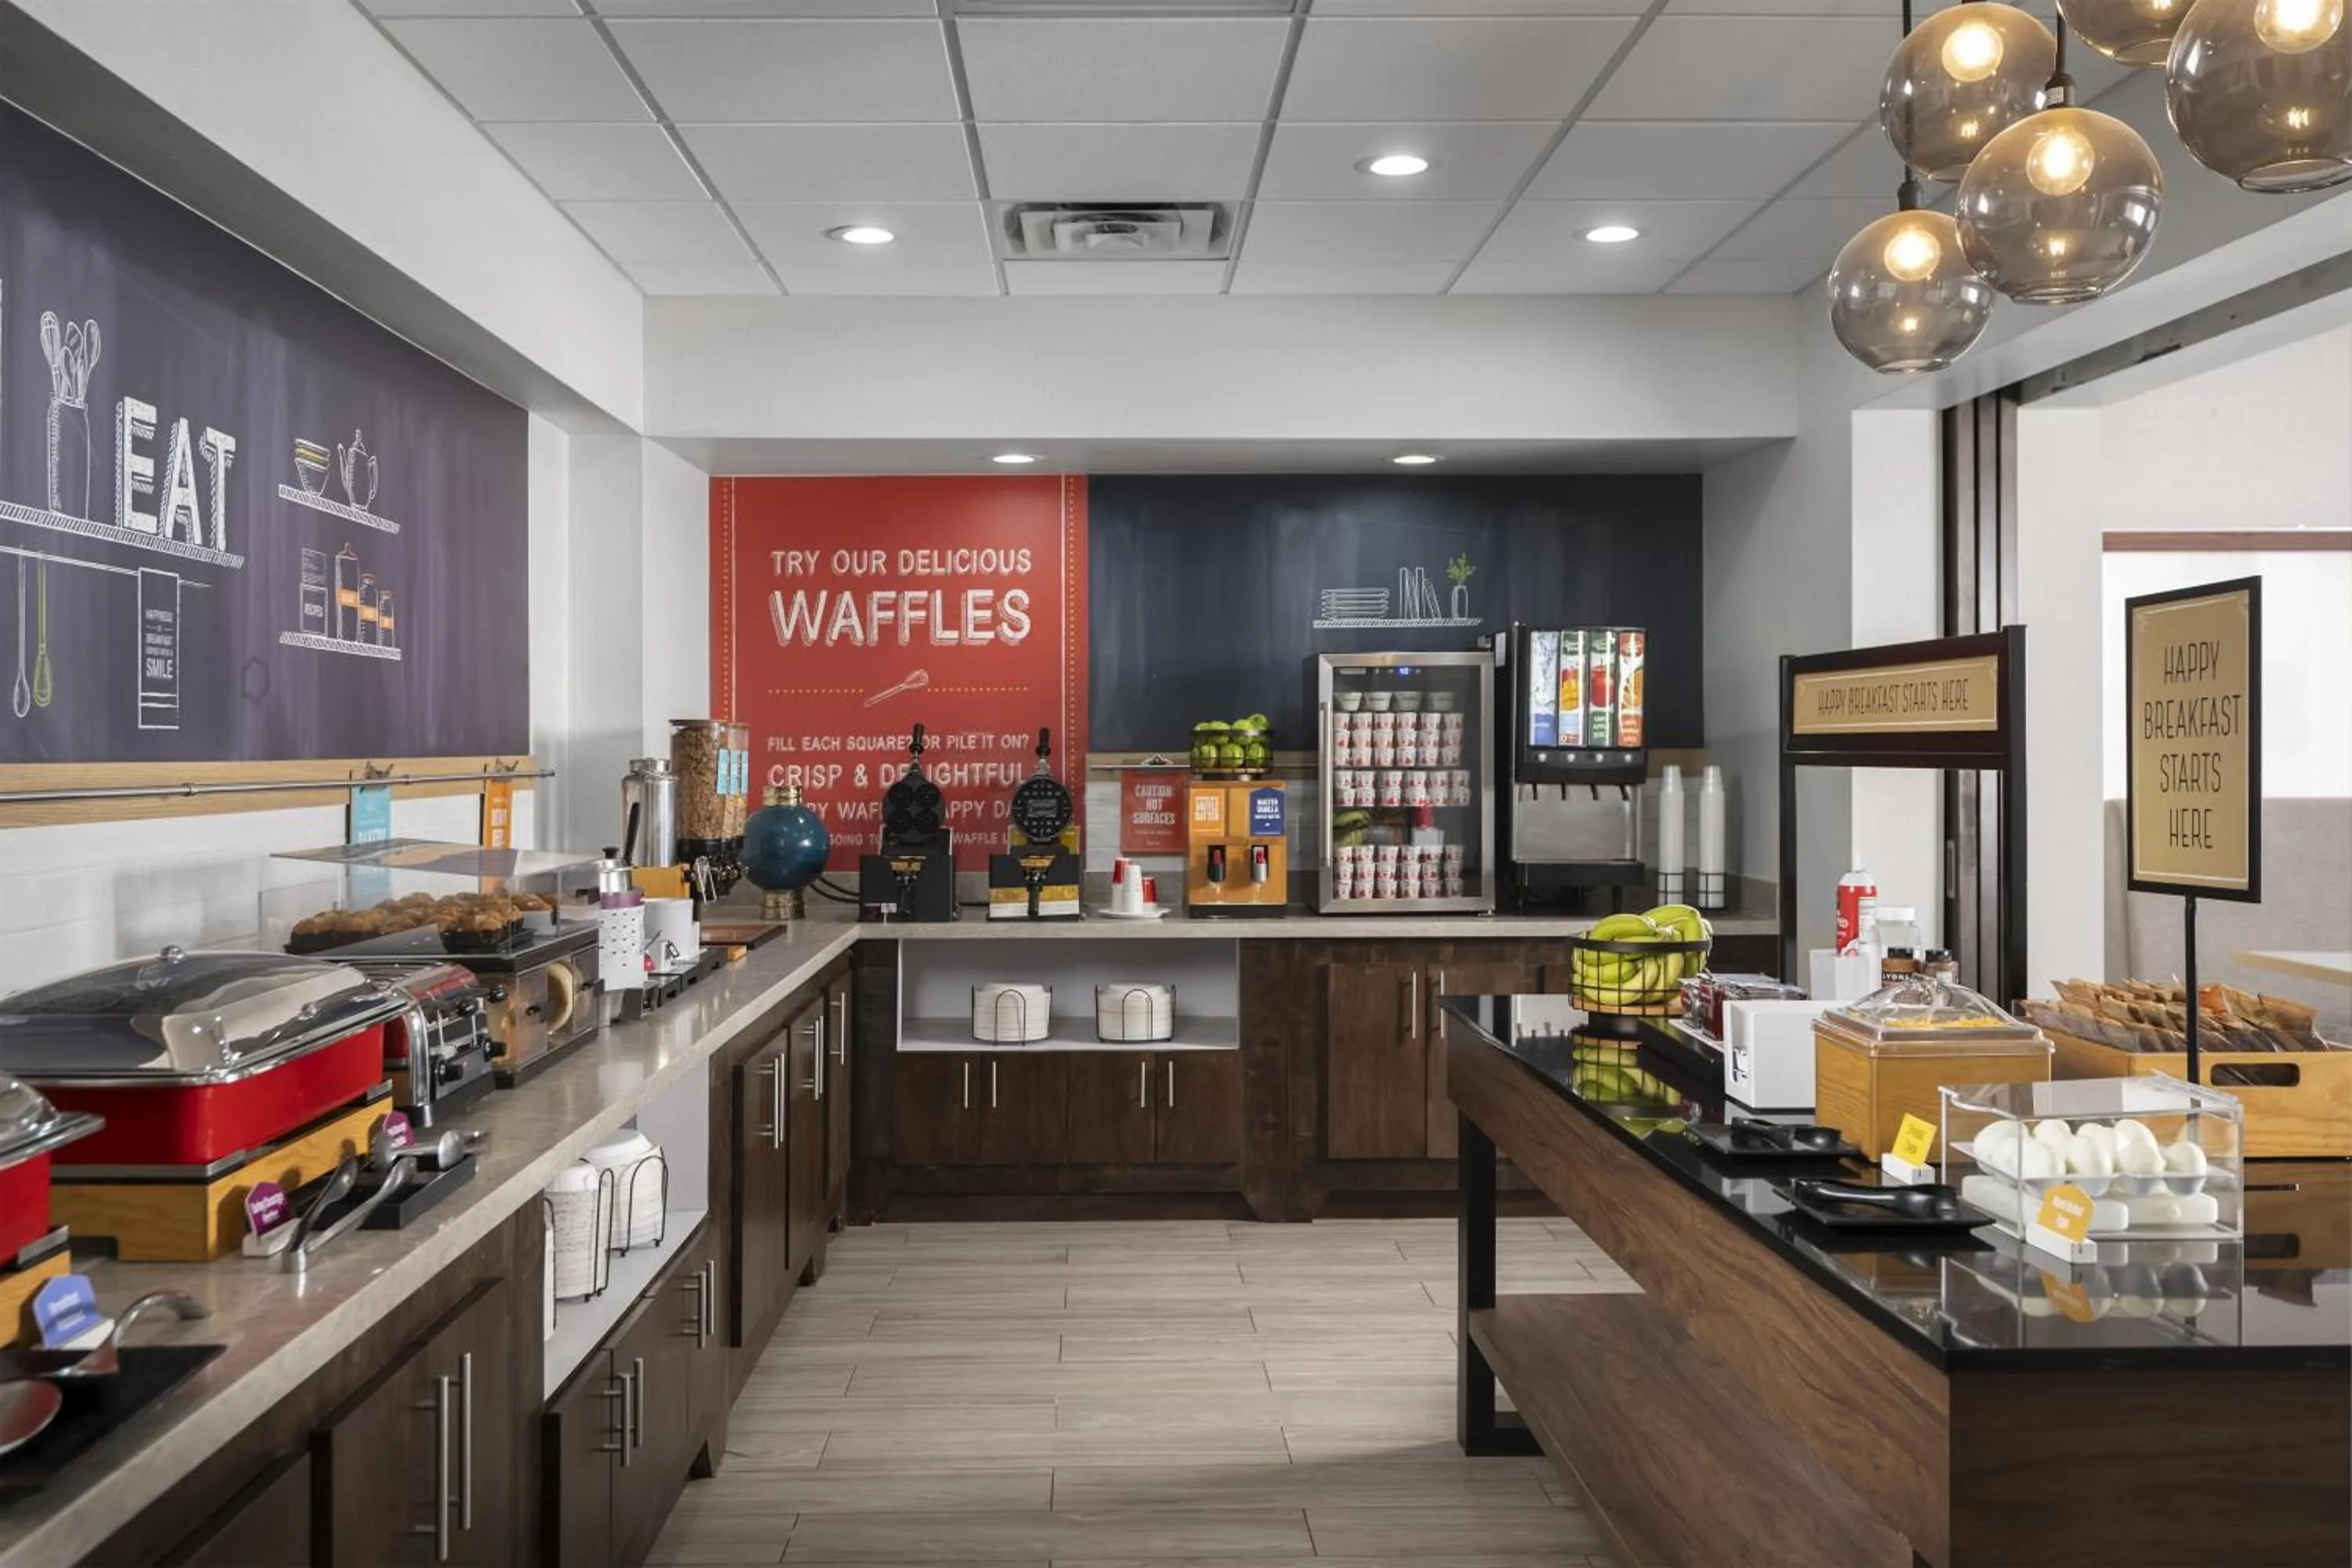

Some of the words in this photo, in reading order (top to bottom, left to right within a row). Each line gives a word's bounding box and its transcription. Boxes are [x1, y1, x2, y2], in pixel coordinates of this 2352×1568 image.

[115, 396, 236, 551] EAT
[771, 550, 820, 576] TRY
[831, 550, 887, 576] OUR
[898, 548, 1032, 576] DELICIOUS
[768, 589, 1031, 647] WAFFLES
[146, 658, 173, 678] SMILE
[2163, 640, 2220, 684] HAPPY
[1818, 688, 1846, 716] HAPPY
[1848, 684, 1900, 717] BREAKFAST
[1903, 681, 1937, 713] STARTS
[1942, 678, 1969, 711] HERE
[2143, 694, 2242, 740] BREAKFAST
[768, 735, 796, 752] FILL
[801, 735, 841, 751] EACH
[921, 734, 940, 750] OR
[946, 734, 977, 750] PILE
[982, 734, 996, 750] IT
[1000, 732, 1029, 750] ON?
[768, 764, 843, 789] CRISP
[853, 762, 868, 789] &
[879, 761, 1026, 789] DEIGHTFUL
[2159, 752, 2222, 793] STARTS
[1134, 783, 1173, 797] CAUTION
[1132, 811, 1176, 824] SURFACES
[1145, 798, 1163, 811] HOT
[953, 832, 998, 844] WAFFLE
[2169, 808, 2213, 849] HERE
